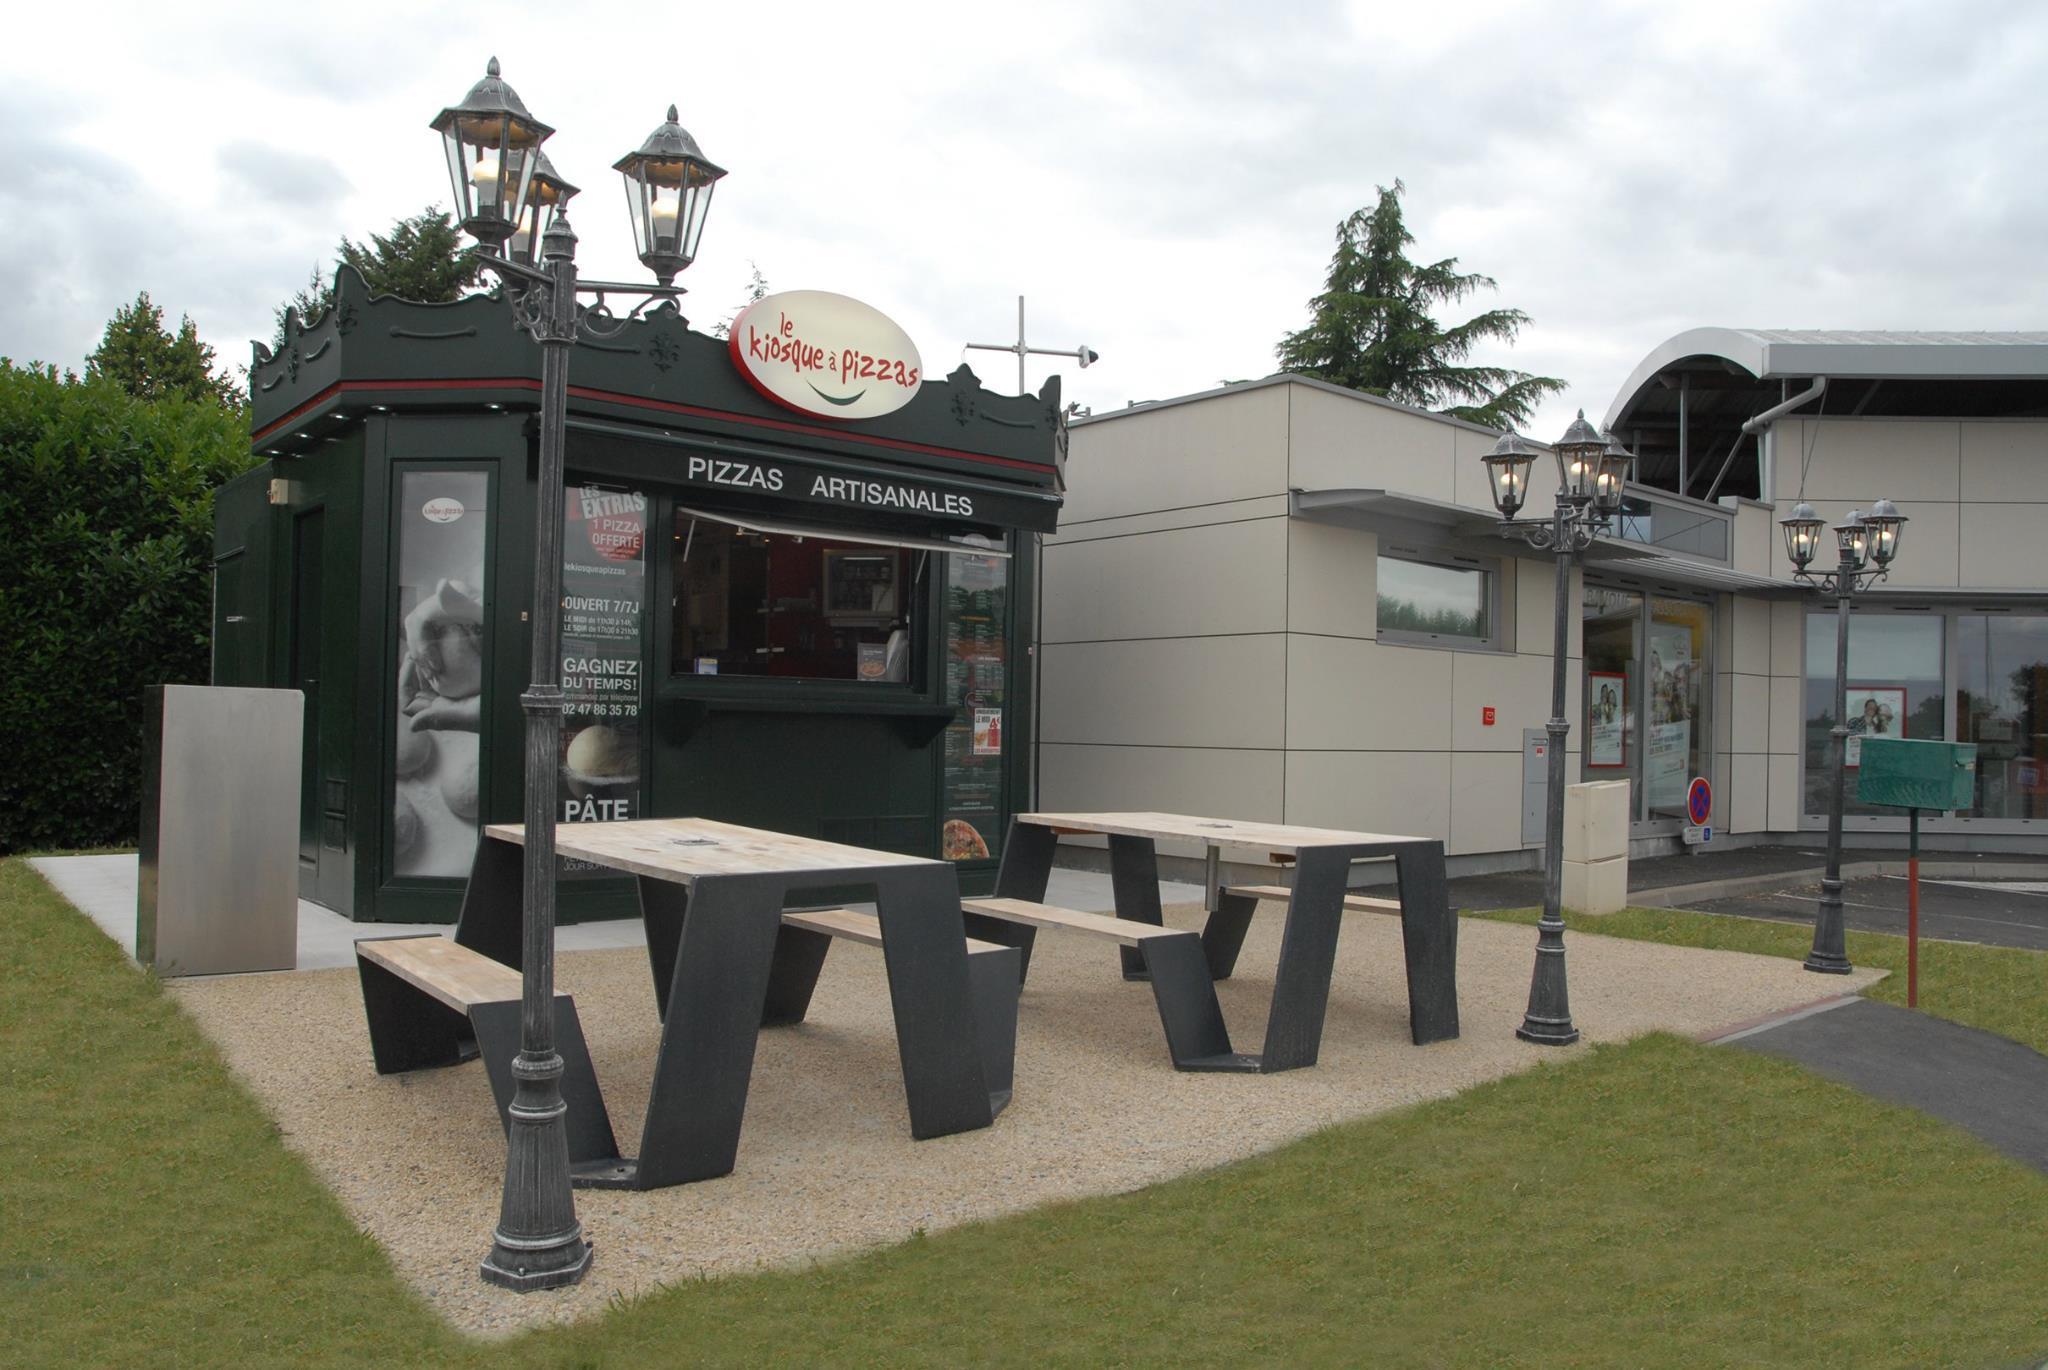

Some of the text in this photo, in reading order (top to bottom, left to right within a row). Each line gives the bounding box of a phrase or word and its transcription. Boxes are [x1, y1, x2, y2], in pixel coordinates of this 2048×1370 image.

[780, 311, 793, 338] le
[750, 325, 918, 387] kiosque à pizzas
[579, 486, 600, 499] LES
[688, 457, 973, 516] PIZZAS ARTISANALES
[581, 492, 646, 519] EXTRAS
[592, 518, 641, 533] 1 PIZZA
[592, 533, 641, 549] OFFERTE
[564, 596, 640, 614] OUVERT 7/7J
[564, 615, 571, 623] LE
[573, 615, 587, 624] MIDI
[573, 624, 587, 633] SOIR
[563, 657, 638, 676] GAGNEZ
[563, 676, 583, 689] DU
[562, 703, 638, 717] 02 47 86 35 78
[565, 793, 629, 822] PÂTE
[563, 862, 585, 872] JOUR
